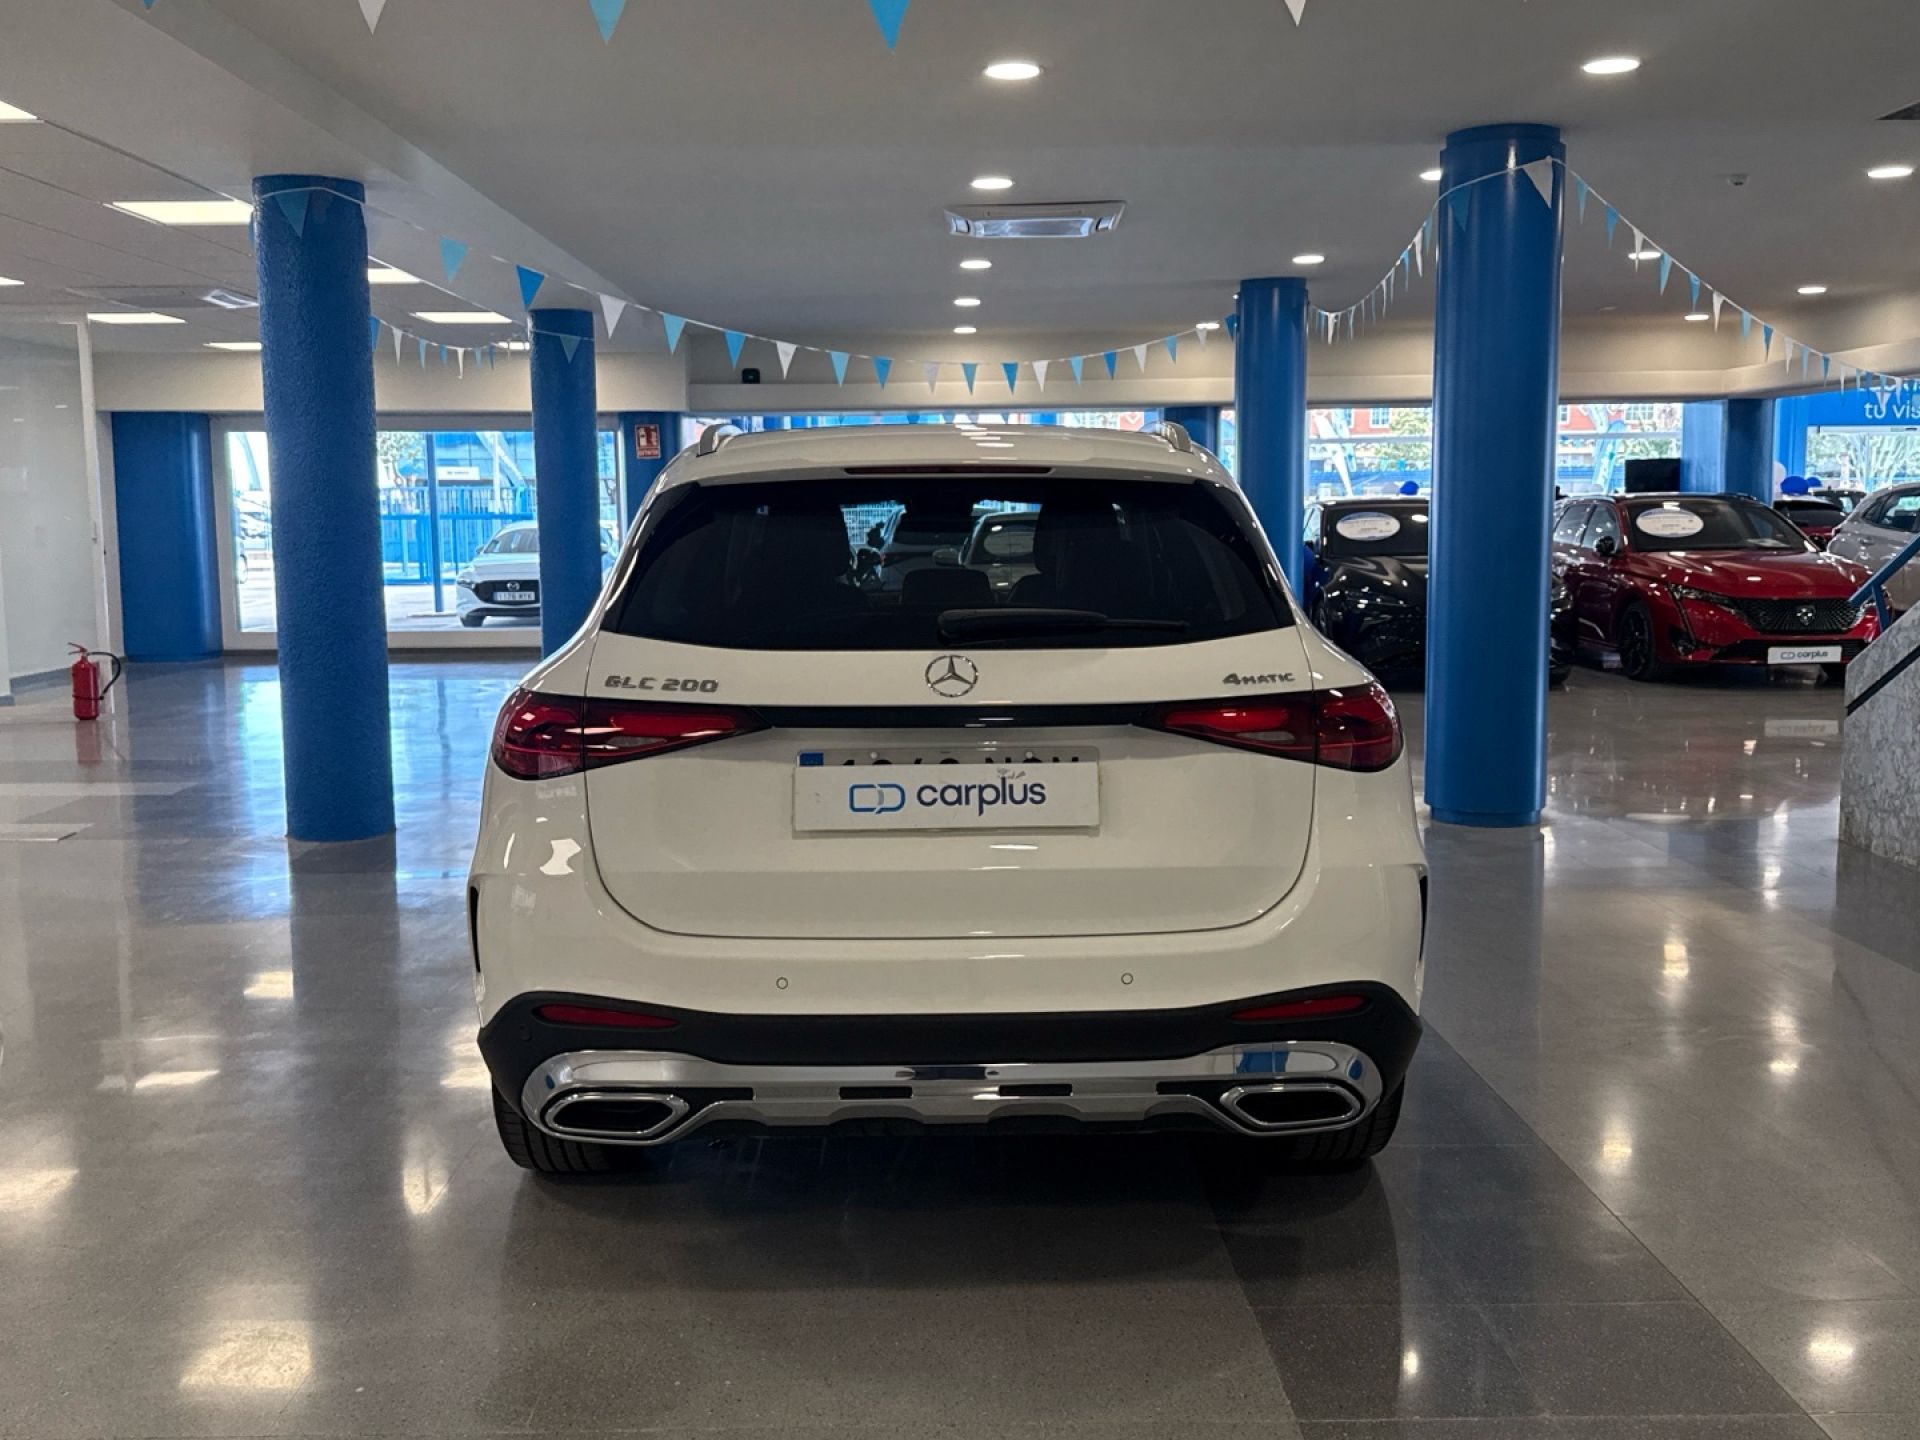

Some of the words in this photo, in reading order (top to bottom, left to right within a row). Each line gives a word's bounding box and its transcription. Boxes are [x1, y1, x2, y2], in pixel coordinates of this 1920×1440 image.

[604, 675, 657, 690] GLC
[660, 678, 719, 693] 200
[916, 776, 1046, 817] carplus
